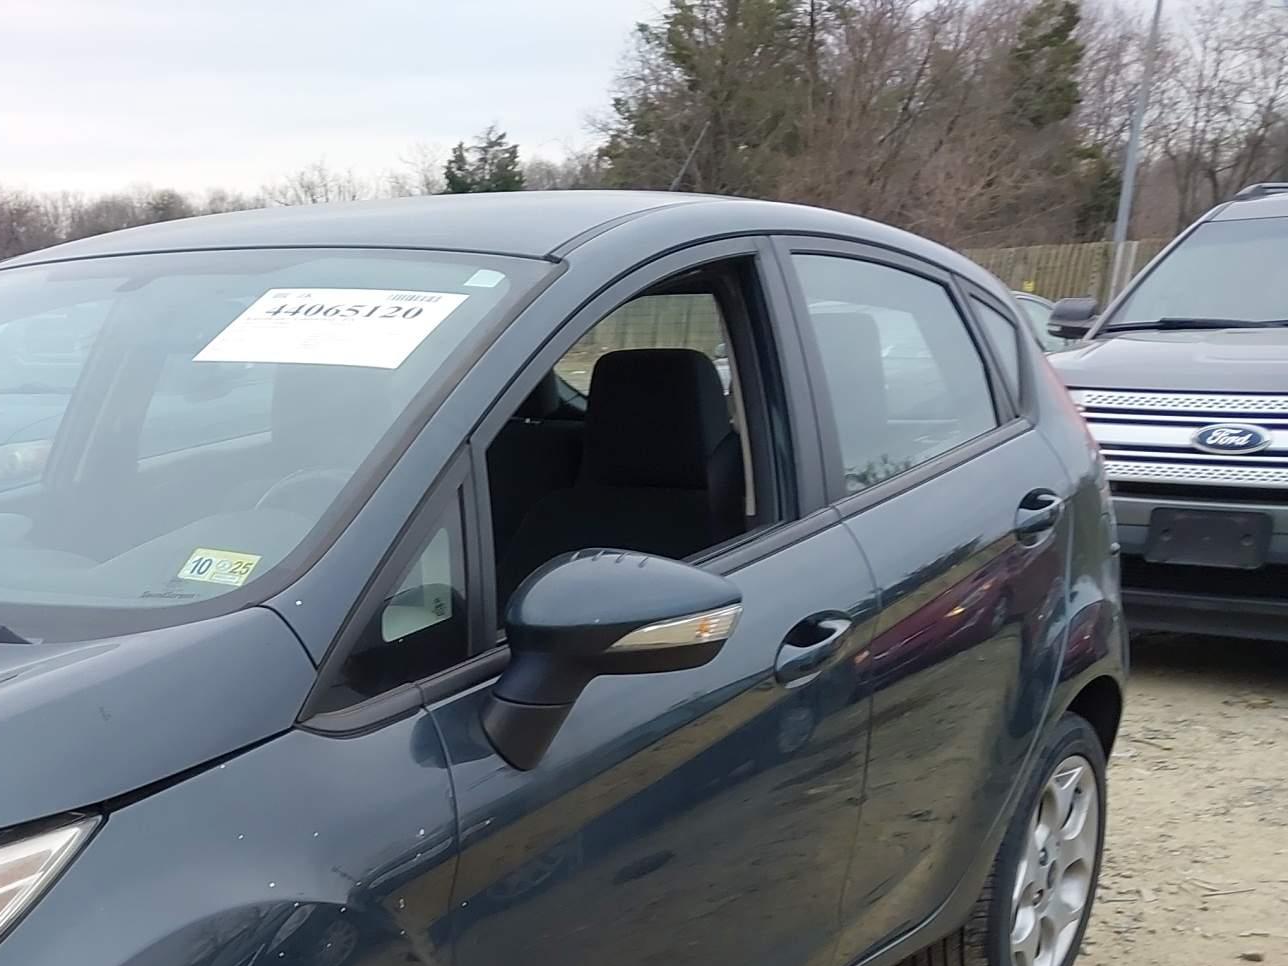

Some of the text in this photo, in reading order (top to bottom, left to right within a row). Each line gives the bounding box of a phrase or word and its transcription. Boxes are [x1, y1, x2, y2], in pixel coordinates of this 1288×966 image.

[266, 303, 424, 319] 44065120
[1207, 428, 1253, 446] Ford
[189, 557, 253, 575] 10 25
